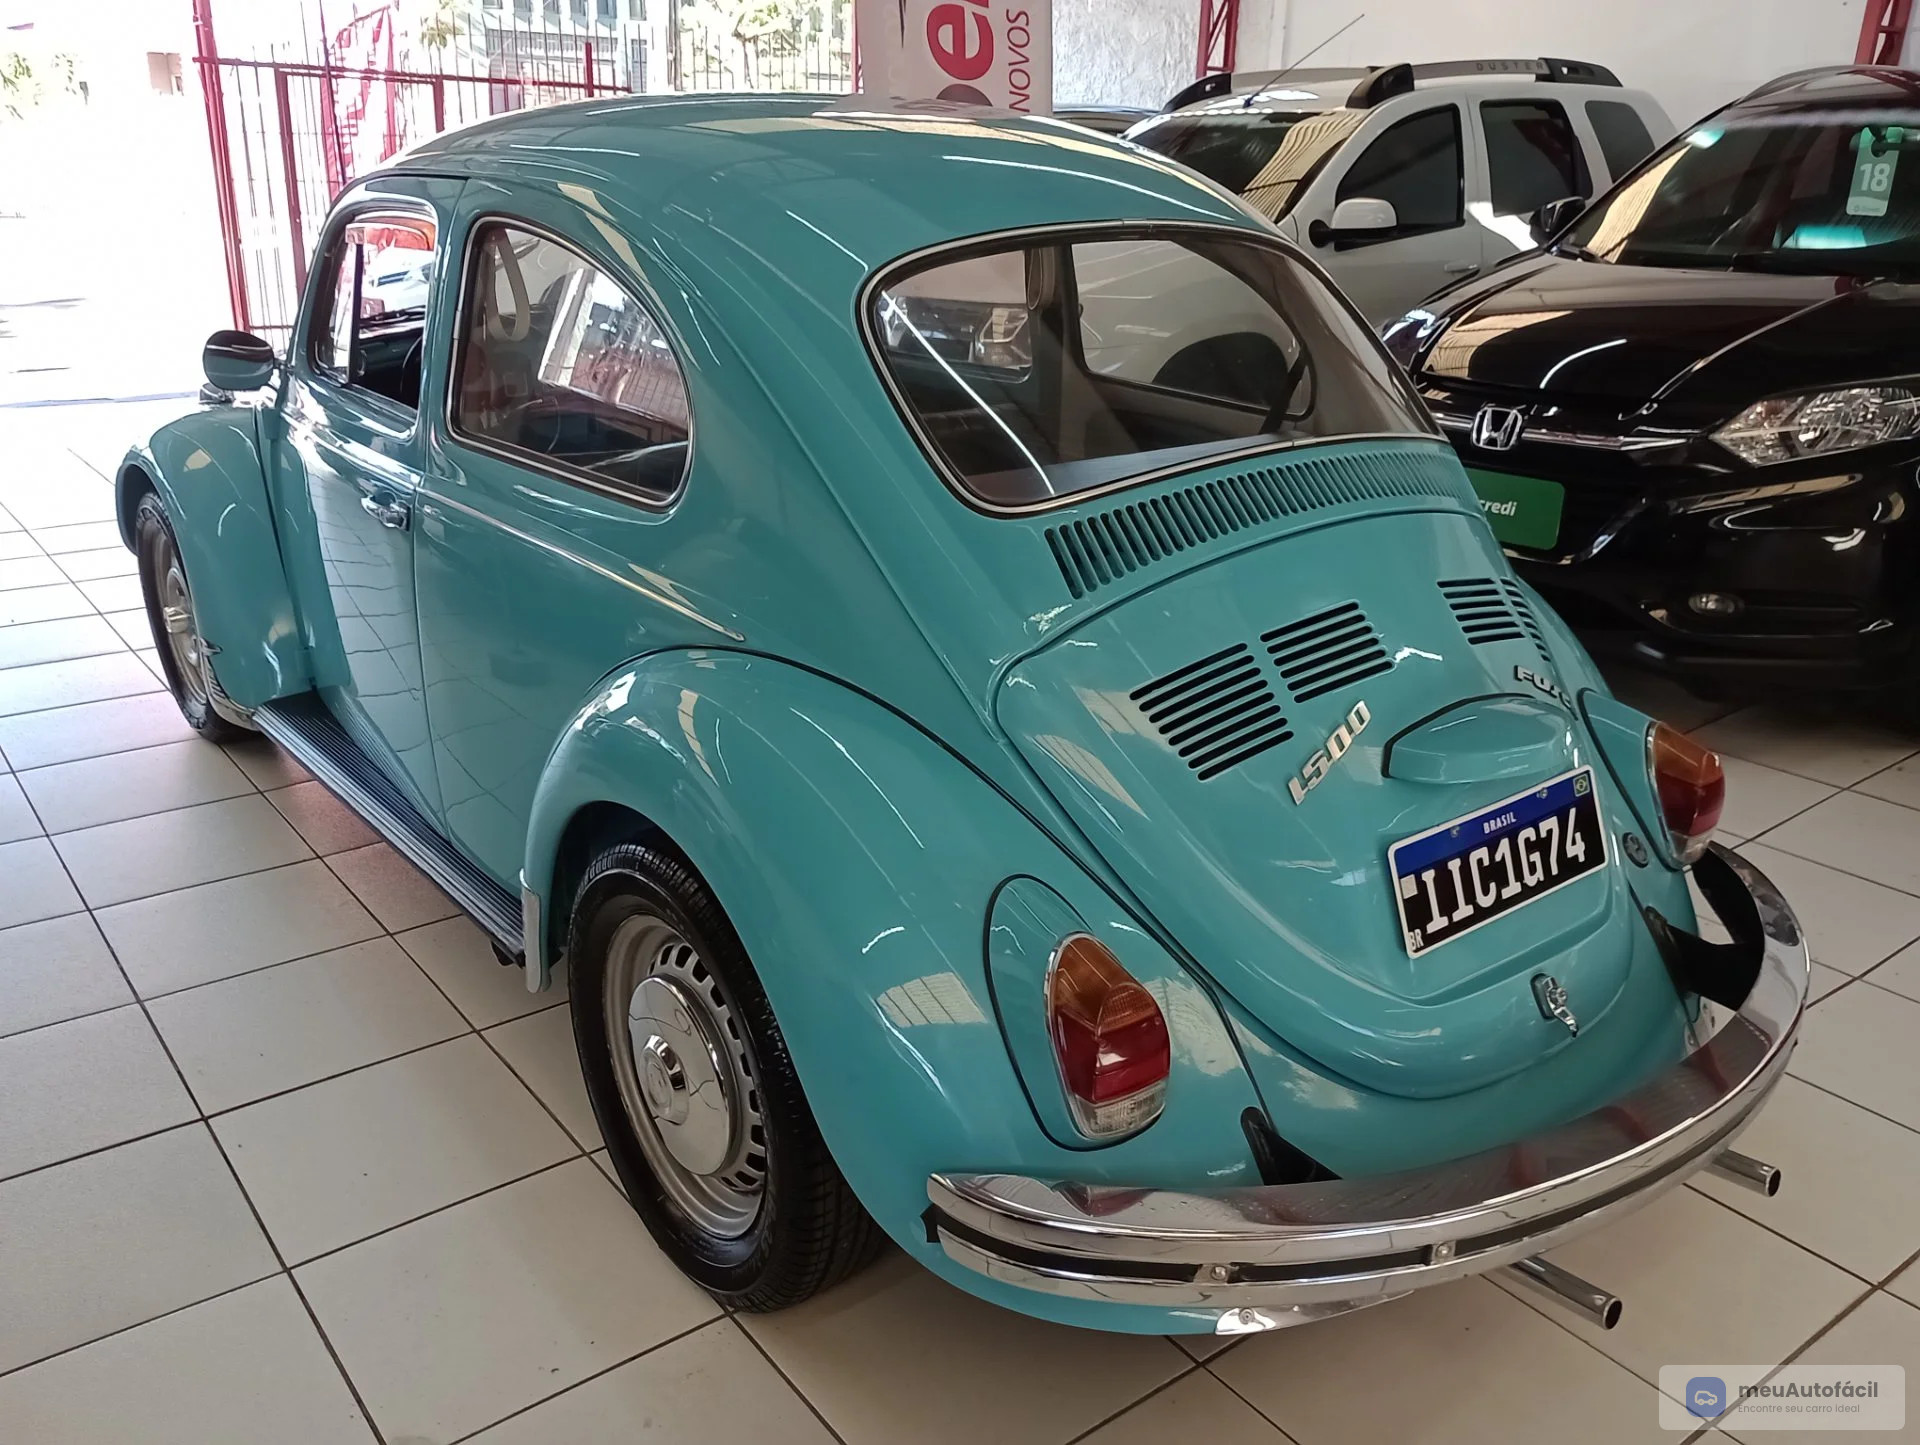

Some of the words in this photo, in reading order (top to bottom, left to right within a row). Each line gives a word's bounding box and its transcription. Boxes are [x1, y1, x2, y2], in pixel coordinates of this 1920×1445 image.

[1475, 61, 1545, 72] DUSTER
[1860, 163, 1891, 192] 18
[1287, 700, 1372, 805] 1500
[1482, 811, 1518, 834] BRASIL
[1421, 807, 1586, 935] IIC1G74
[1407, 928, 1424, 951] BR
